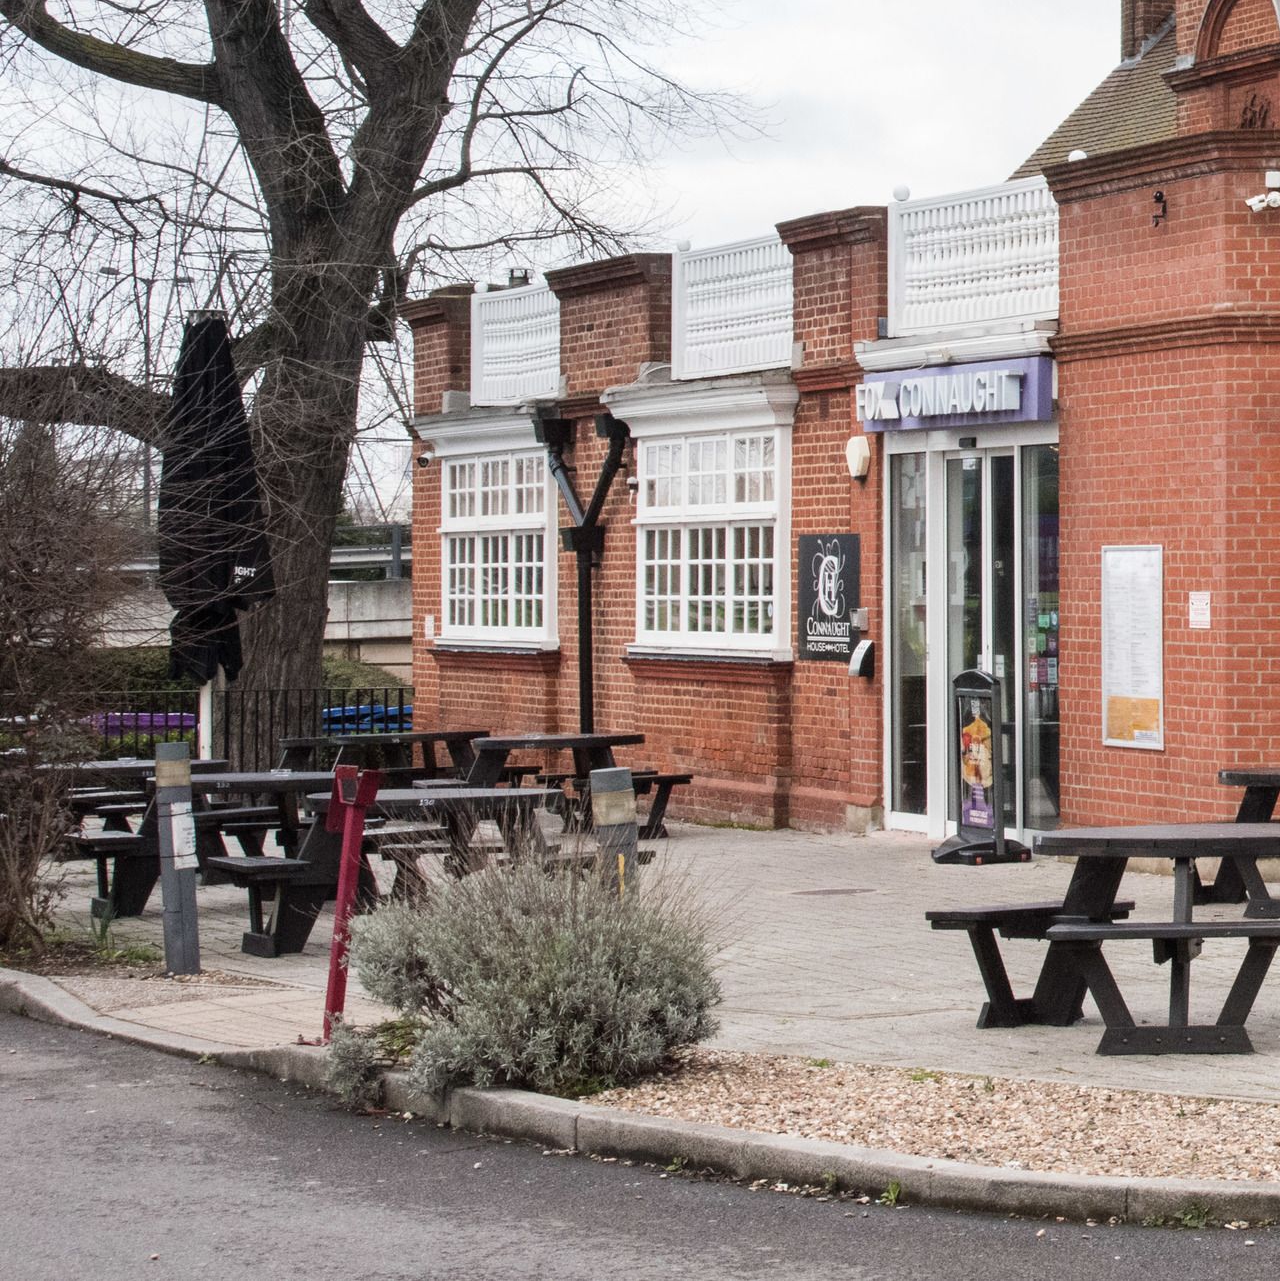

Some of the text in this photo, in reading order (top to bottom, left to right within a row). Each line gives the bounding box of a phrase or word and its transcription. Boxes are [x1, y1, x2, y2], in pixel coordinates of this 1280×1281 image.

[855, 369, 1024, 422] FOX CONNAUGHT
[806, 616, 851, 637] CONNAUGHT
[806, 642, 850, 654] HOUSE HOTEL
